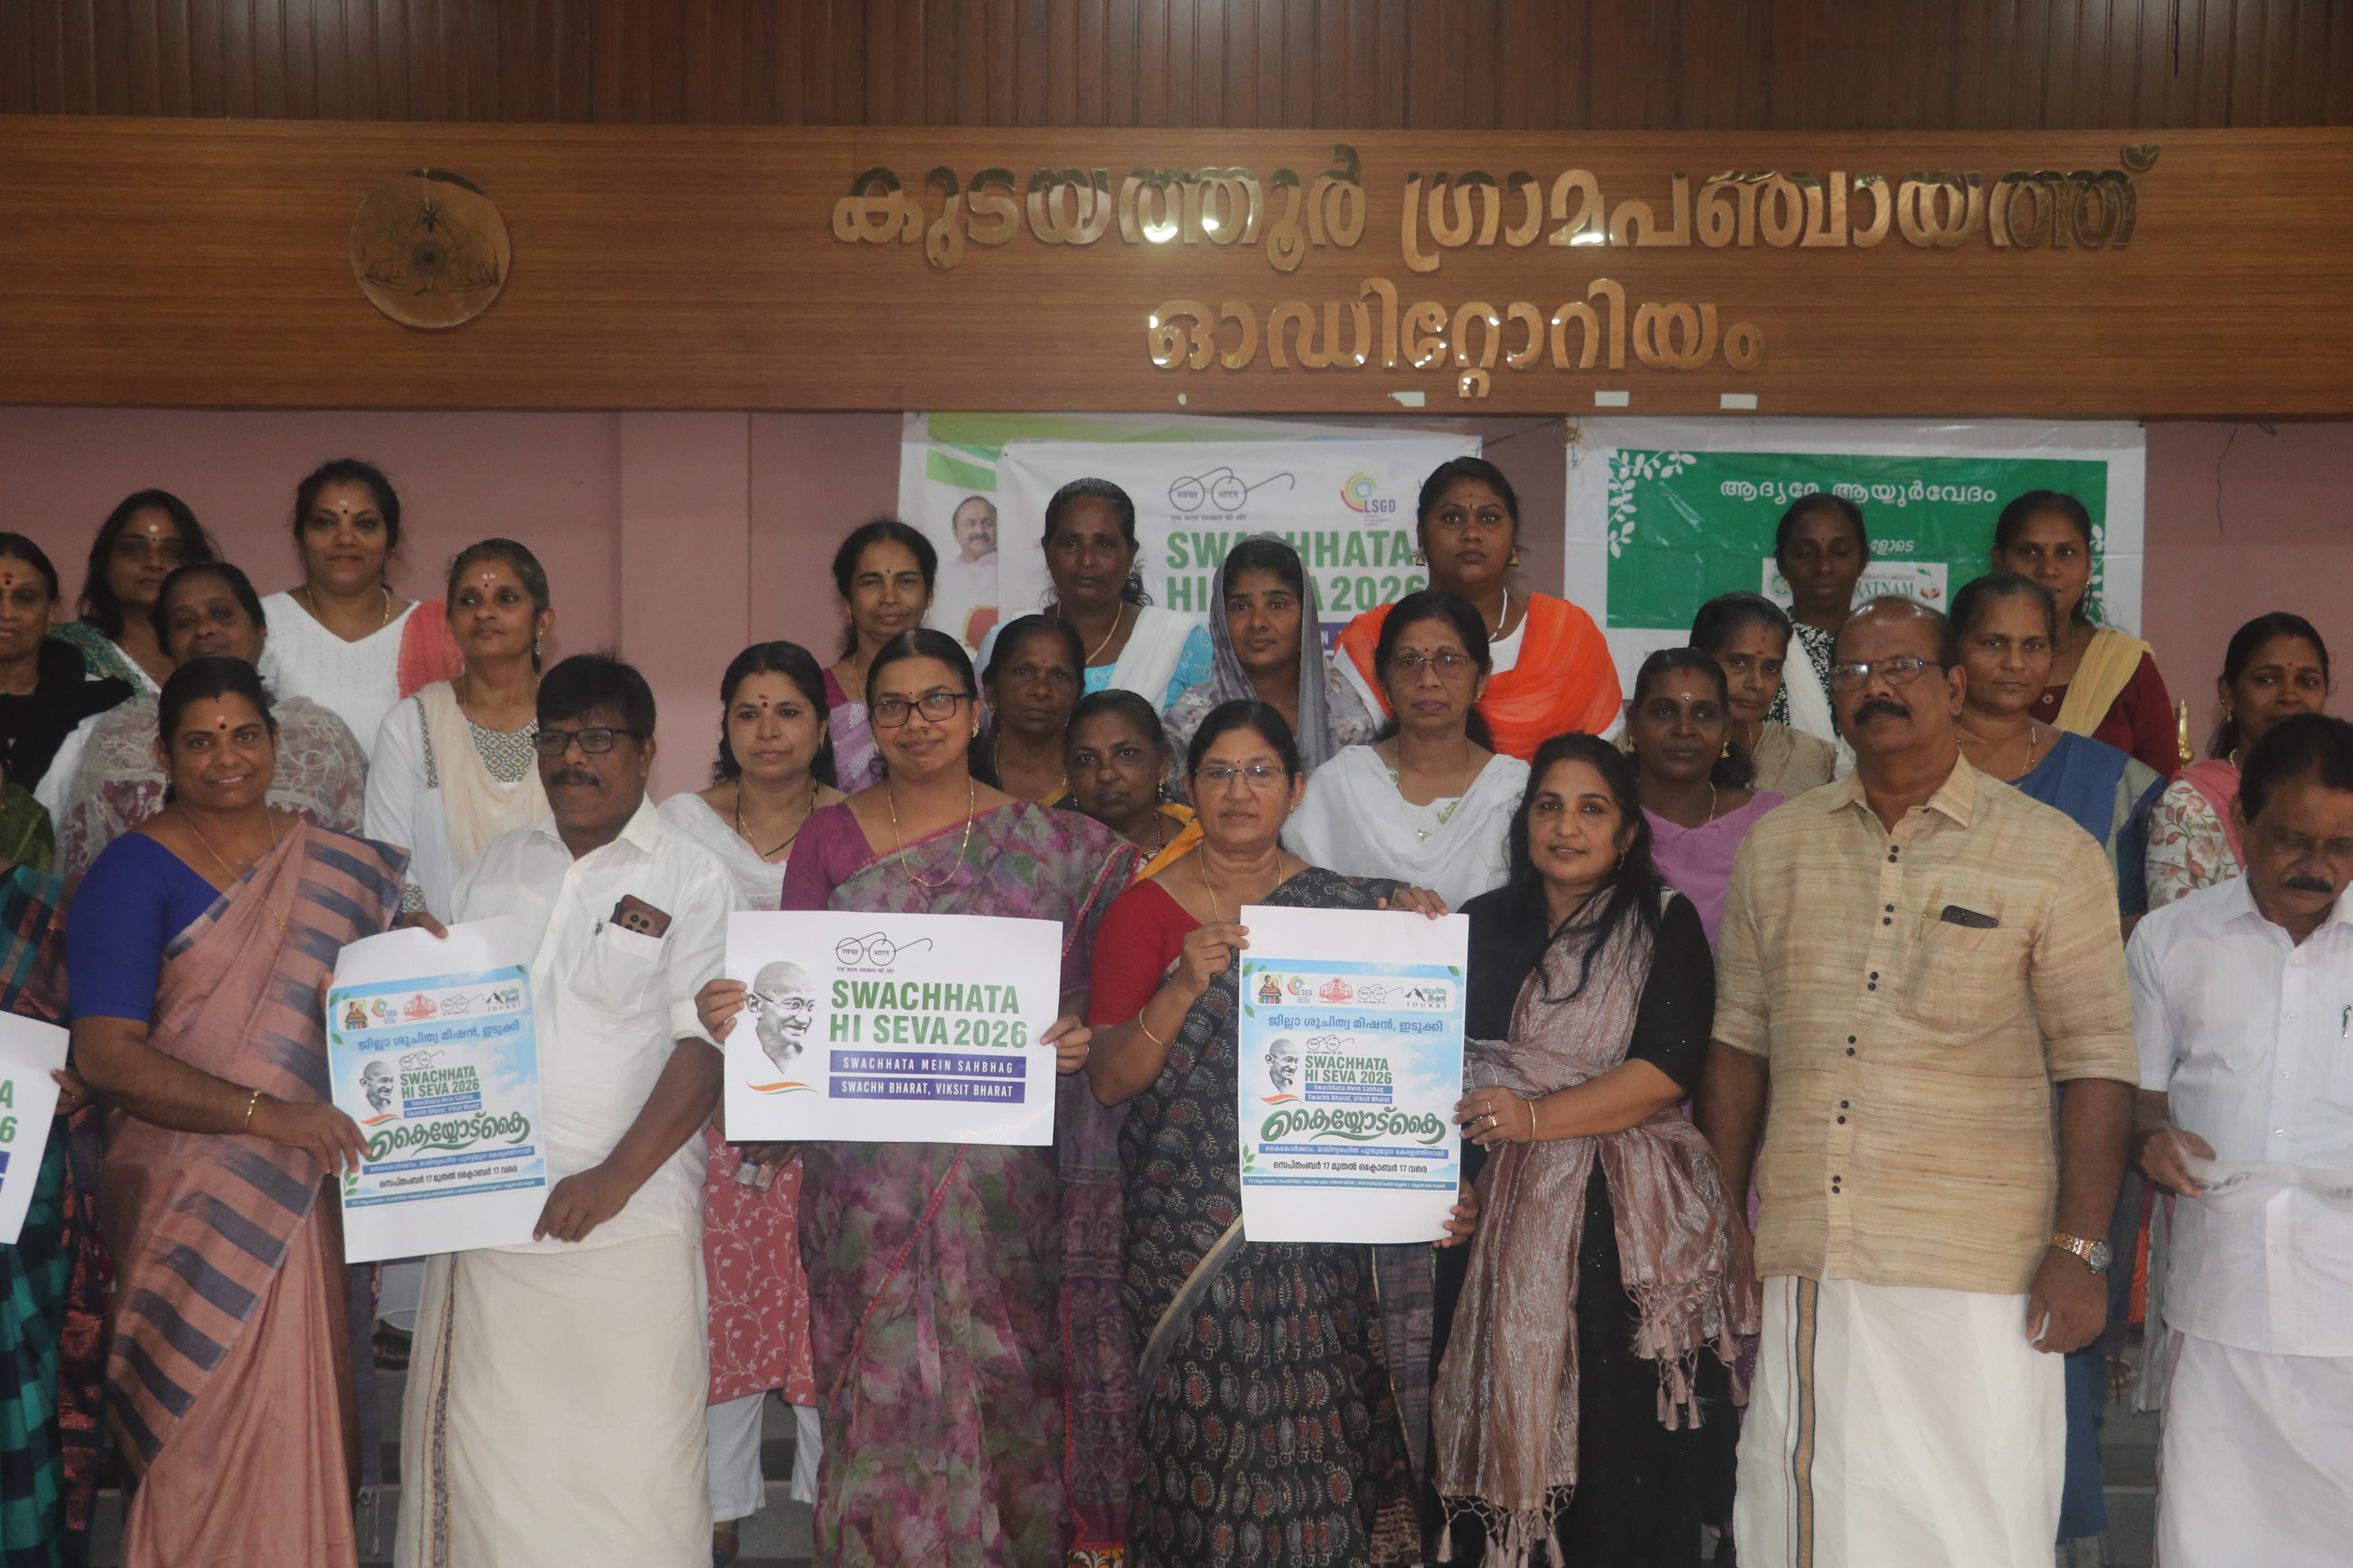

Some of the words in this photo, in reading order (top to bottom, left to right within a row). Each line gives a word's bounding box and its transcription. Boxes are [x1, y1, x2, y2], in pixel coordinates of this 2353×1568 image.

[832, 144, 1367, 271] കുടയത്തൂർ
[1400, 143, 2160, 272] ഗ്രാമപഞ്ചായത്ത്
[1148, 278, 1764, 398] ഓഡിറ്റോറിയം
[1365, 499, 1395, 512] LSGD
[1167, 530, 1414, 569] SWHHATA
[831, 979, 1020, 1014] SWACHHATA
[830, 1014, 861, 1042] HI
[873, 1014, 949, 1045] SEVA
[954, 1018, 1027, 1048] 2026
[1269, 1014, 1300, 1030] ജില്ലാ
[1304, 1016, 1350, 1030] ശുചിത്വ
[1399, 1020, 1442, 1034] ഇടുക്കി
[843, 1057, 915, 1070] SWACHHATA
[921, 1059, 951, 1071] MEIN
[958, 1061, 1013, 1074] SAHBHAG
[1305, 1055, 1389, 1071] SWACHHATA
[400, 1065, 476, 1086] SWACHHATA
[1305, 1069, 1318, 1081] HI
[1322, 1069, 1356, 1083] SEVA
[1360, 1071, 1392, 1084] 2026
[401, 1086, 415, 1099] HI
[419, 1082, 449, 1098] SEVA
[453, 1078, 480, 1094] 2026
[842, 1081, 884, 1094] SWACHH
[889, 1082, 931, 1096] BHARAT,
[936, 1083, 969, 1096] VIKSIT
[973, 1085, 1013, 1098] BHARAT
